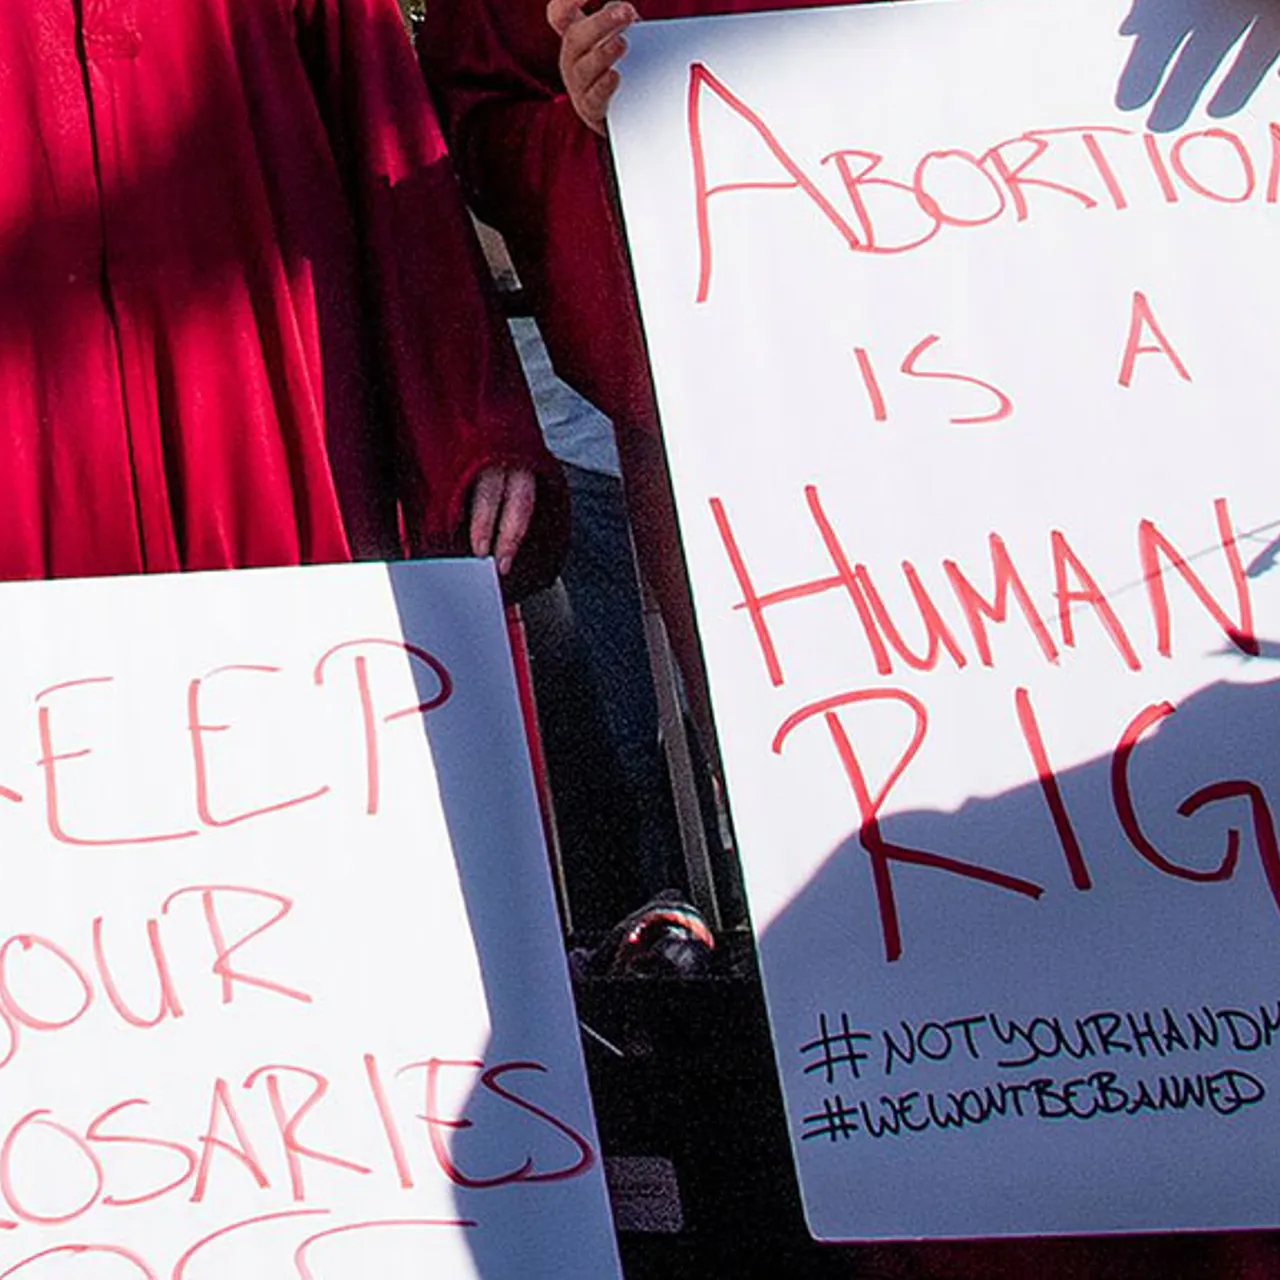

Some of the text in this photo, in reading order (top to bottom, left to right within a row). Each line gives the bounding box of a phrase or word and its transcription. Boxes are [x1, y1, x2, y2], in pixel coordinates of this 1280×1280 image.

[853, 290, 1193, 424] IS A
[707, 483, 1260, 686] HUMAN
[801, 1070, 1265, 1142] #WEWONTBEBANNED
